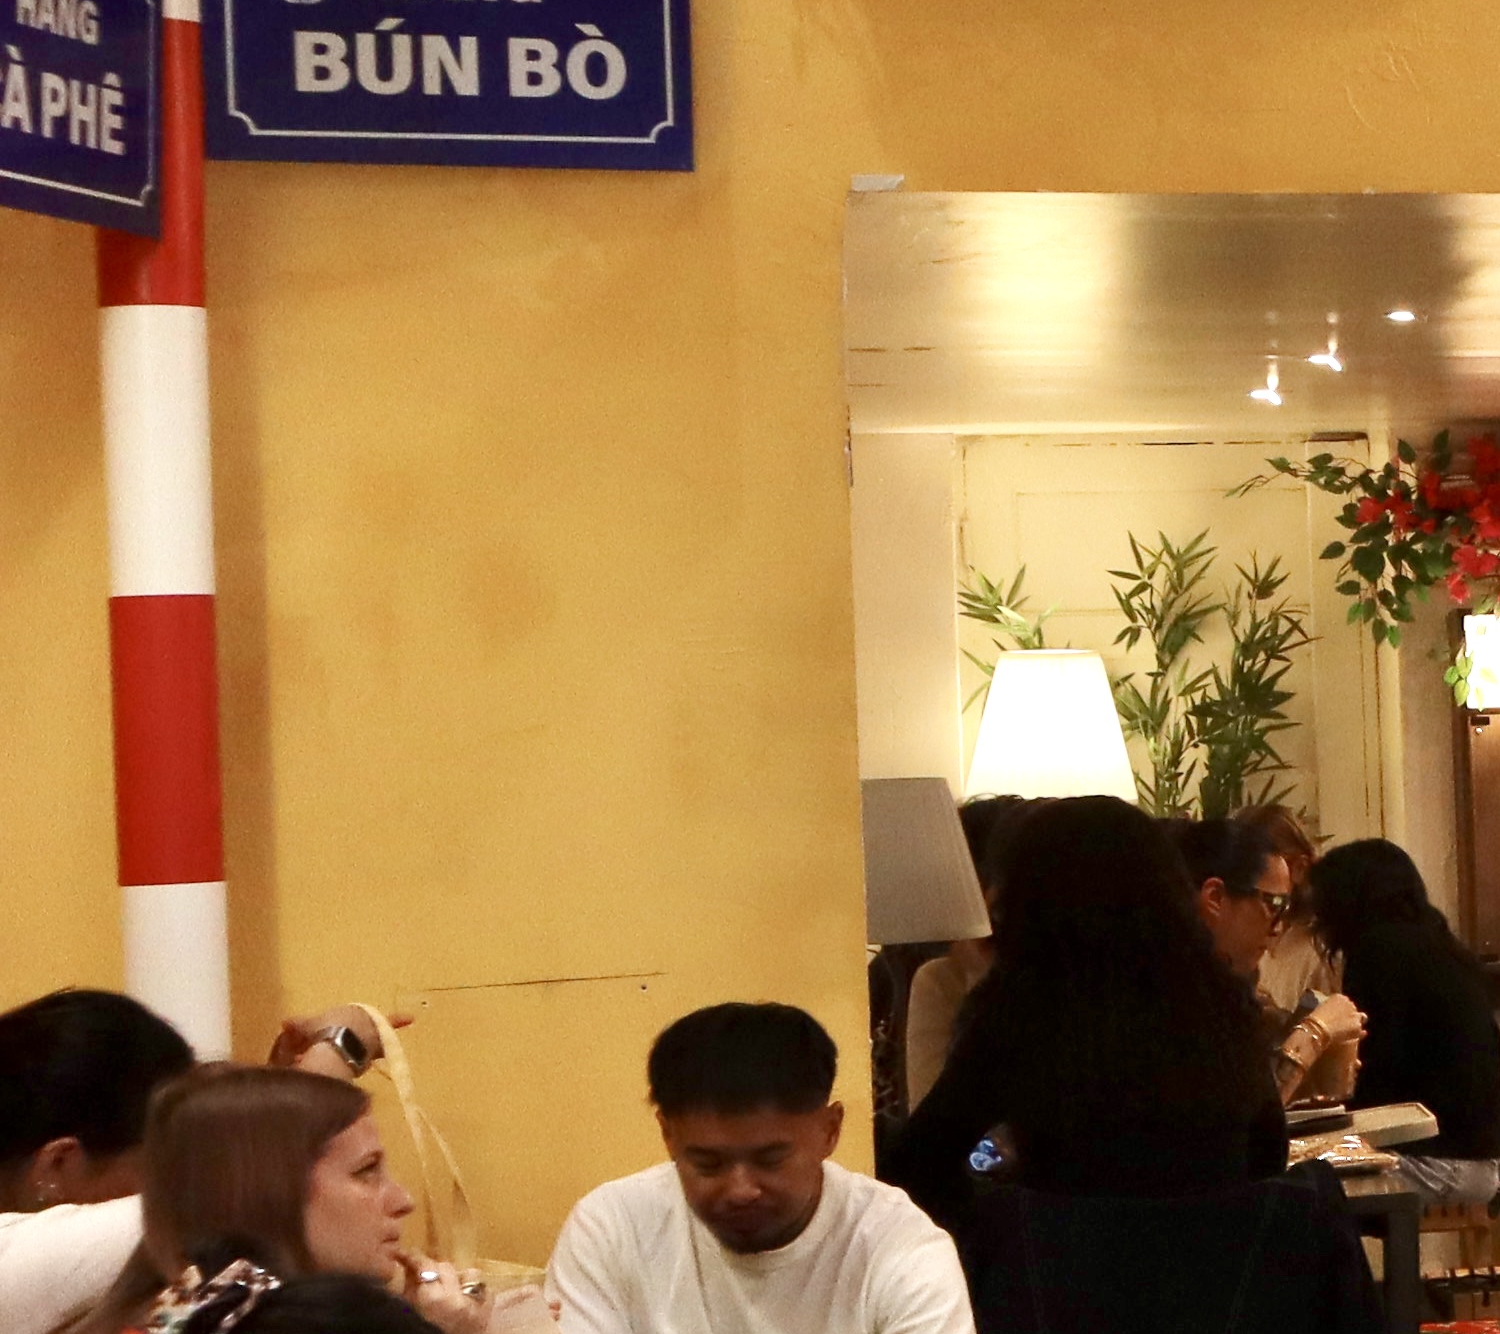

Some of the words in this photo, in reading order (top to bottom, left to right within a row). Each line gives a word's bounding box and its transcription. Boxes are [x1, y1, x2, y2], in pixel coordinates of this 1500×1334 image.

[0, 44, 34, 134] À
[40, 70, 126, 156] PHÊ
[292, 19, 482, 97] BÚN
[507, 23, 627, 100] BÒ
